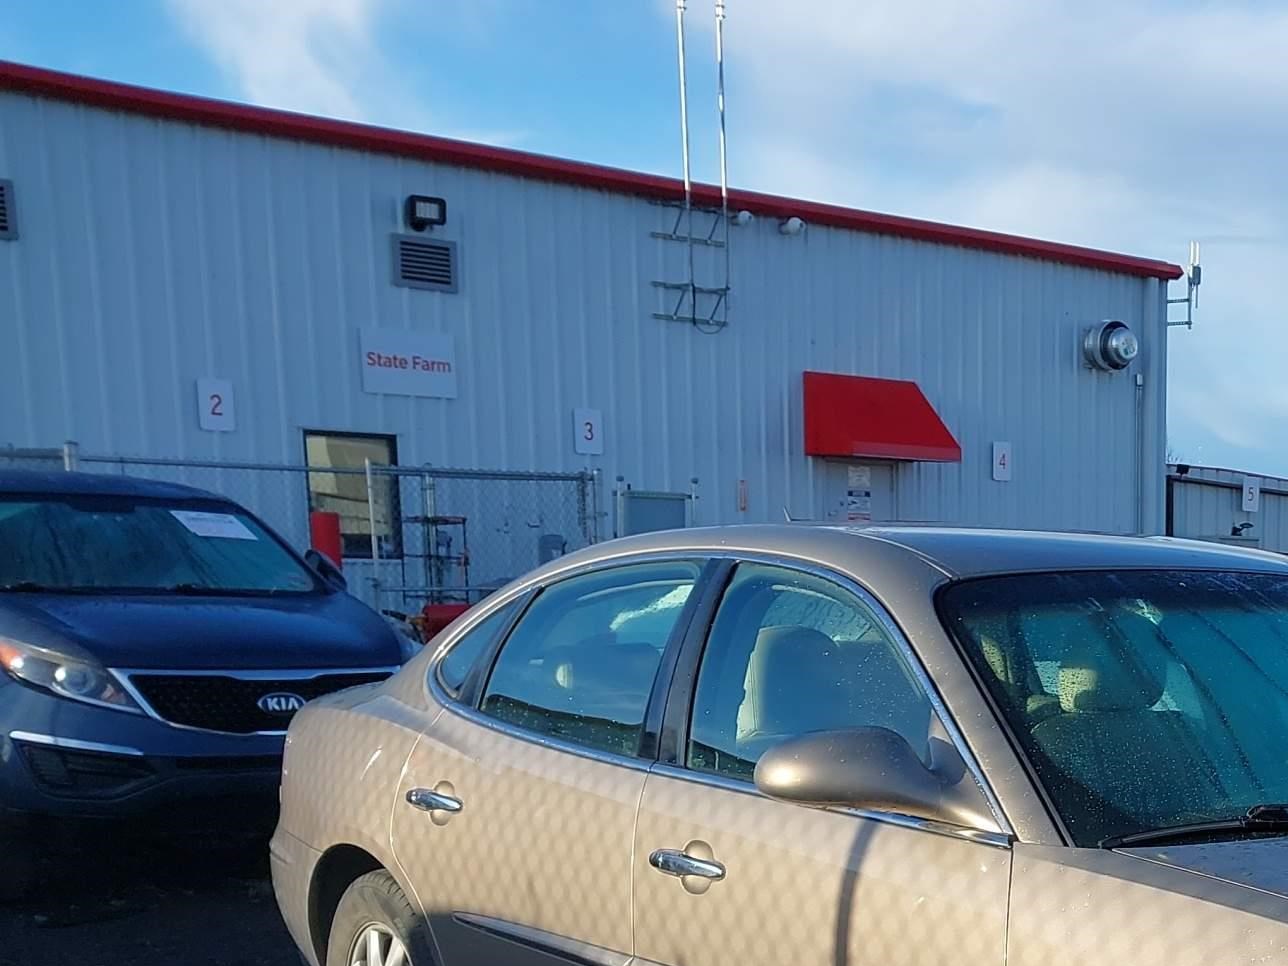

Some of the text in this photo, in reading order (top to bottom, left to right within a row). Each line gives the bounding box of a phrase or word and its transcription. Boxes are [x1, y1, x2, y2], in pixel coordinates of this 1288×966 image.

[367, 351, 452, 373] State Farm
[209, 394, 223, 415] 2
[583, 421, 594, 441] 3
[998, 452, 1007, 471] 4
[1247, 486, 1255, 502] 5
[266, 697, 299, 712] KIA
